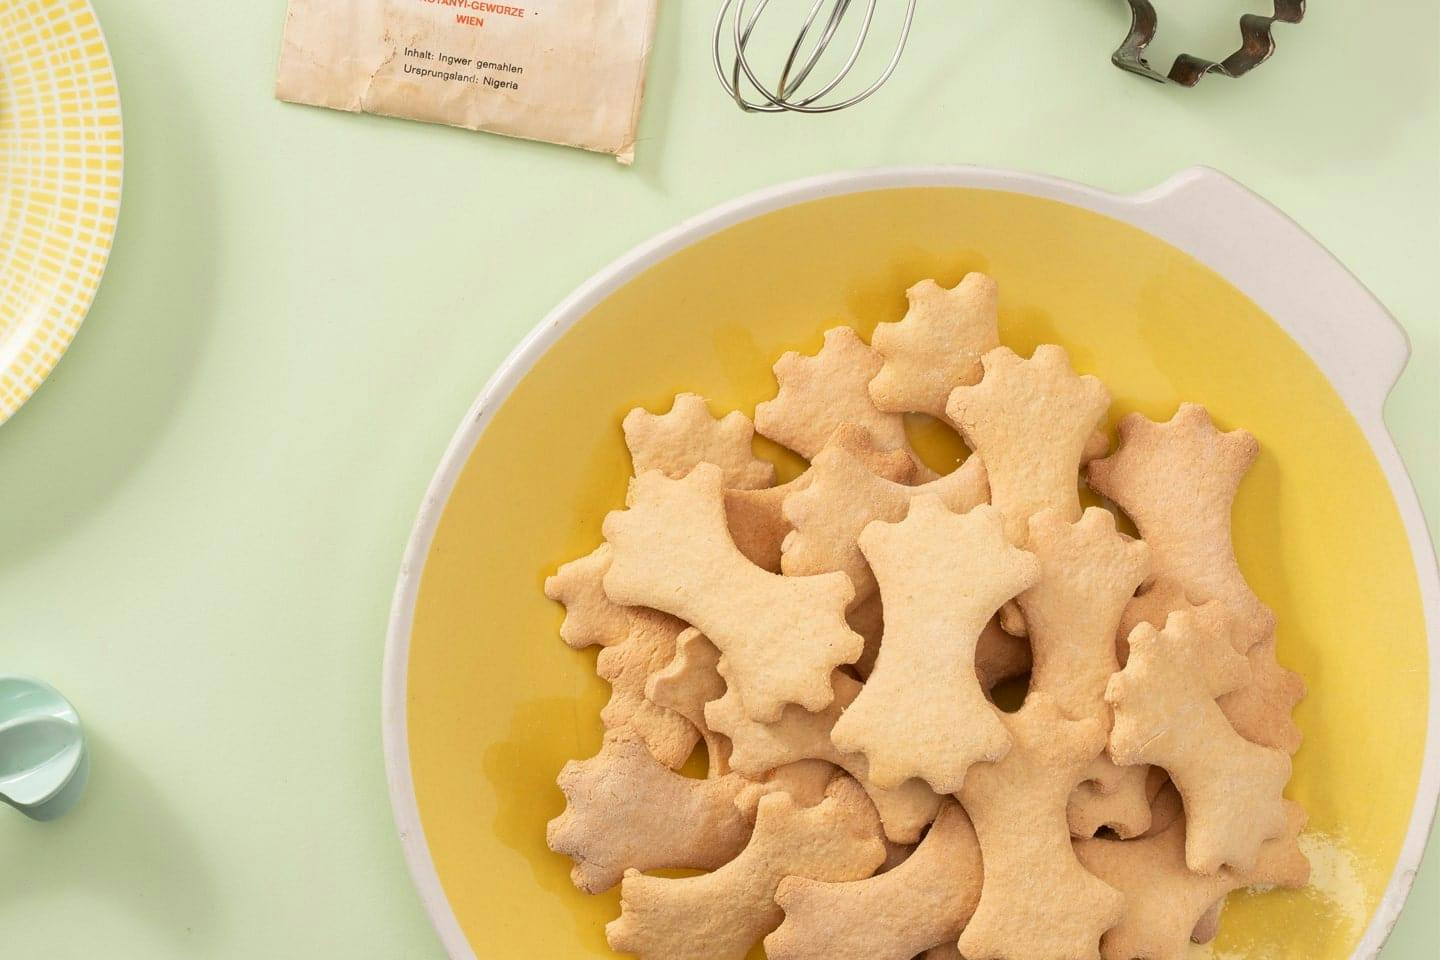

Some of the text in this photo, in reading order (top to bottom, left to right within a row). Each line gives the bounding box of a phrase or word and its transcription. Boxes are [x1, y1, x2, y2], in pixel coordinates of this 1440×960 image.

[456, 14, 484, 28] WIEN
[404, 46, 524, 75] Inhalt: Ingwer gemahlen
[403, 63, 518, 90] Ursprungsland: Nigeria
